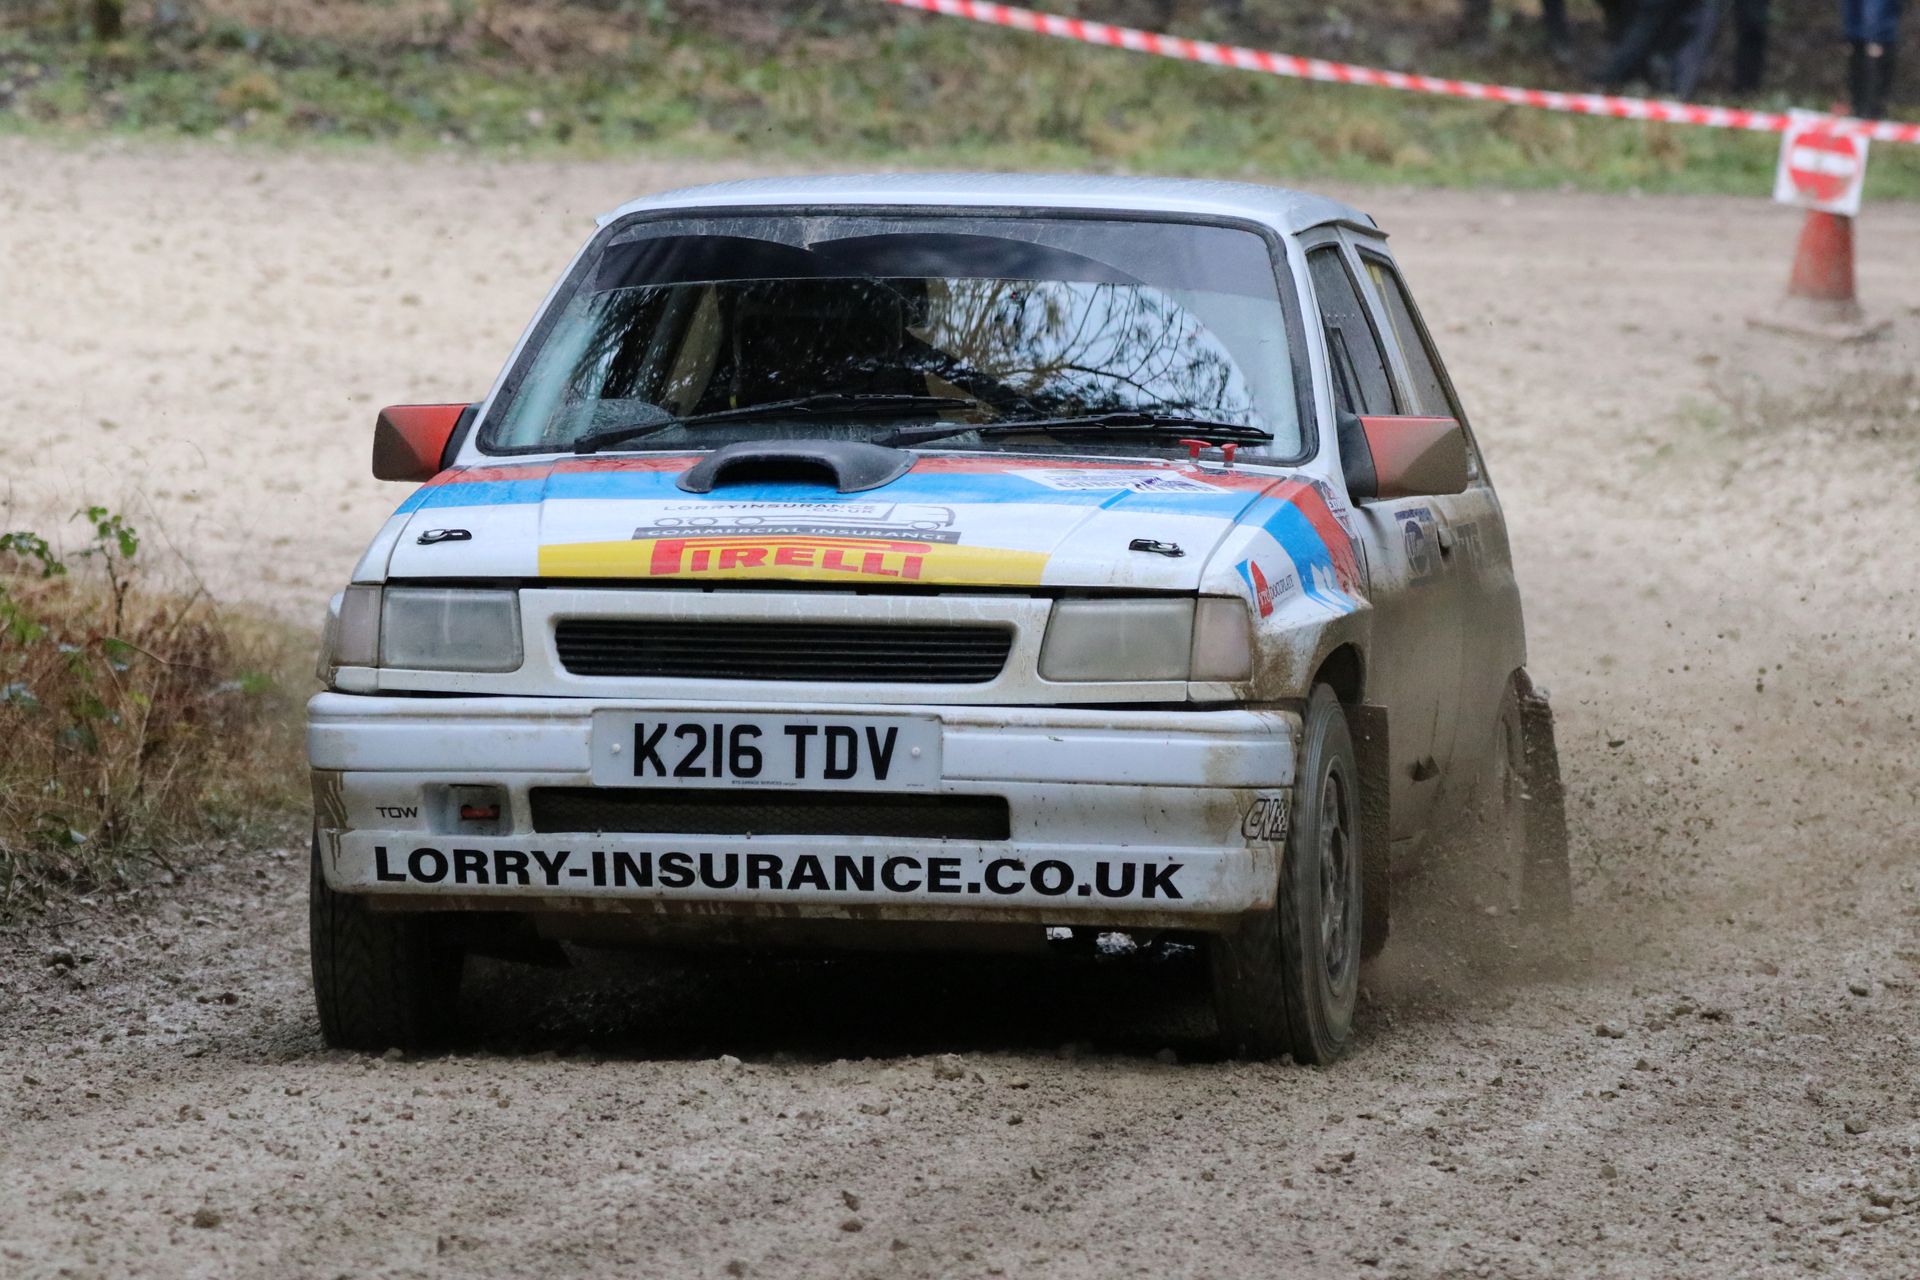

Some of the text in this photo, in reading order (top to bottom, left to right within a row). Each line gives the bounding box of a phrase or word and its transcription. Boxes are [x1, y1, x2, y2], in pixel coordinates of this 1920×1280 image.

[647, 527, 947, 541] COMMERCIAL INSURANCE
[650, 536, 932, 580] PIRELLI
[633, 723, 899, 780] K216 TDV
[375, 806, 418, 819] TOW
[374, 846, 1183, 899] LORRY-INSURANCE.CO.UK
